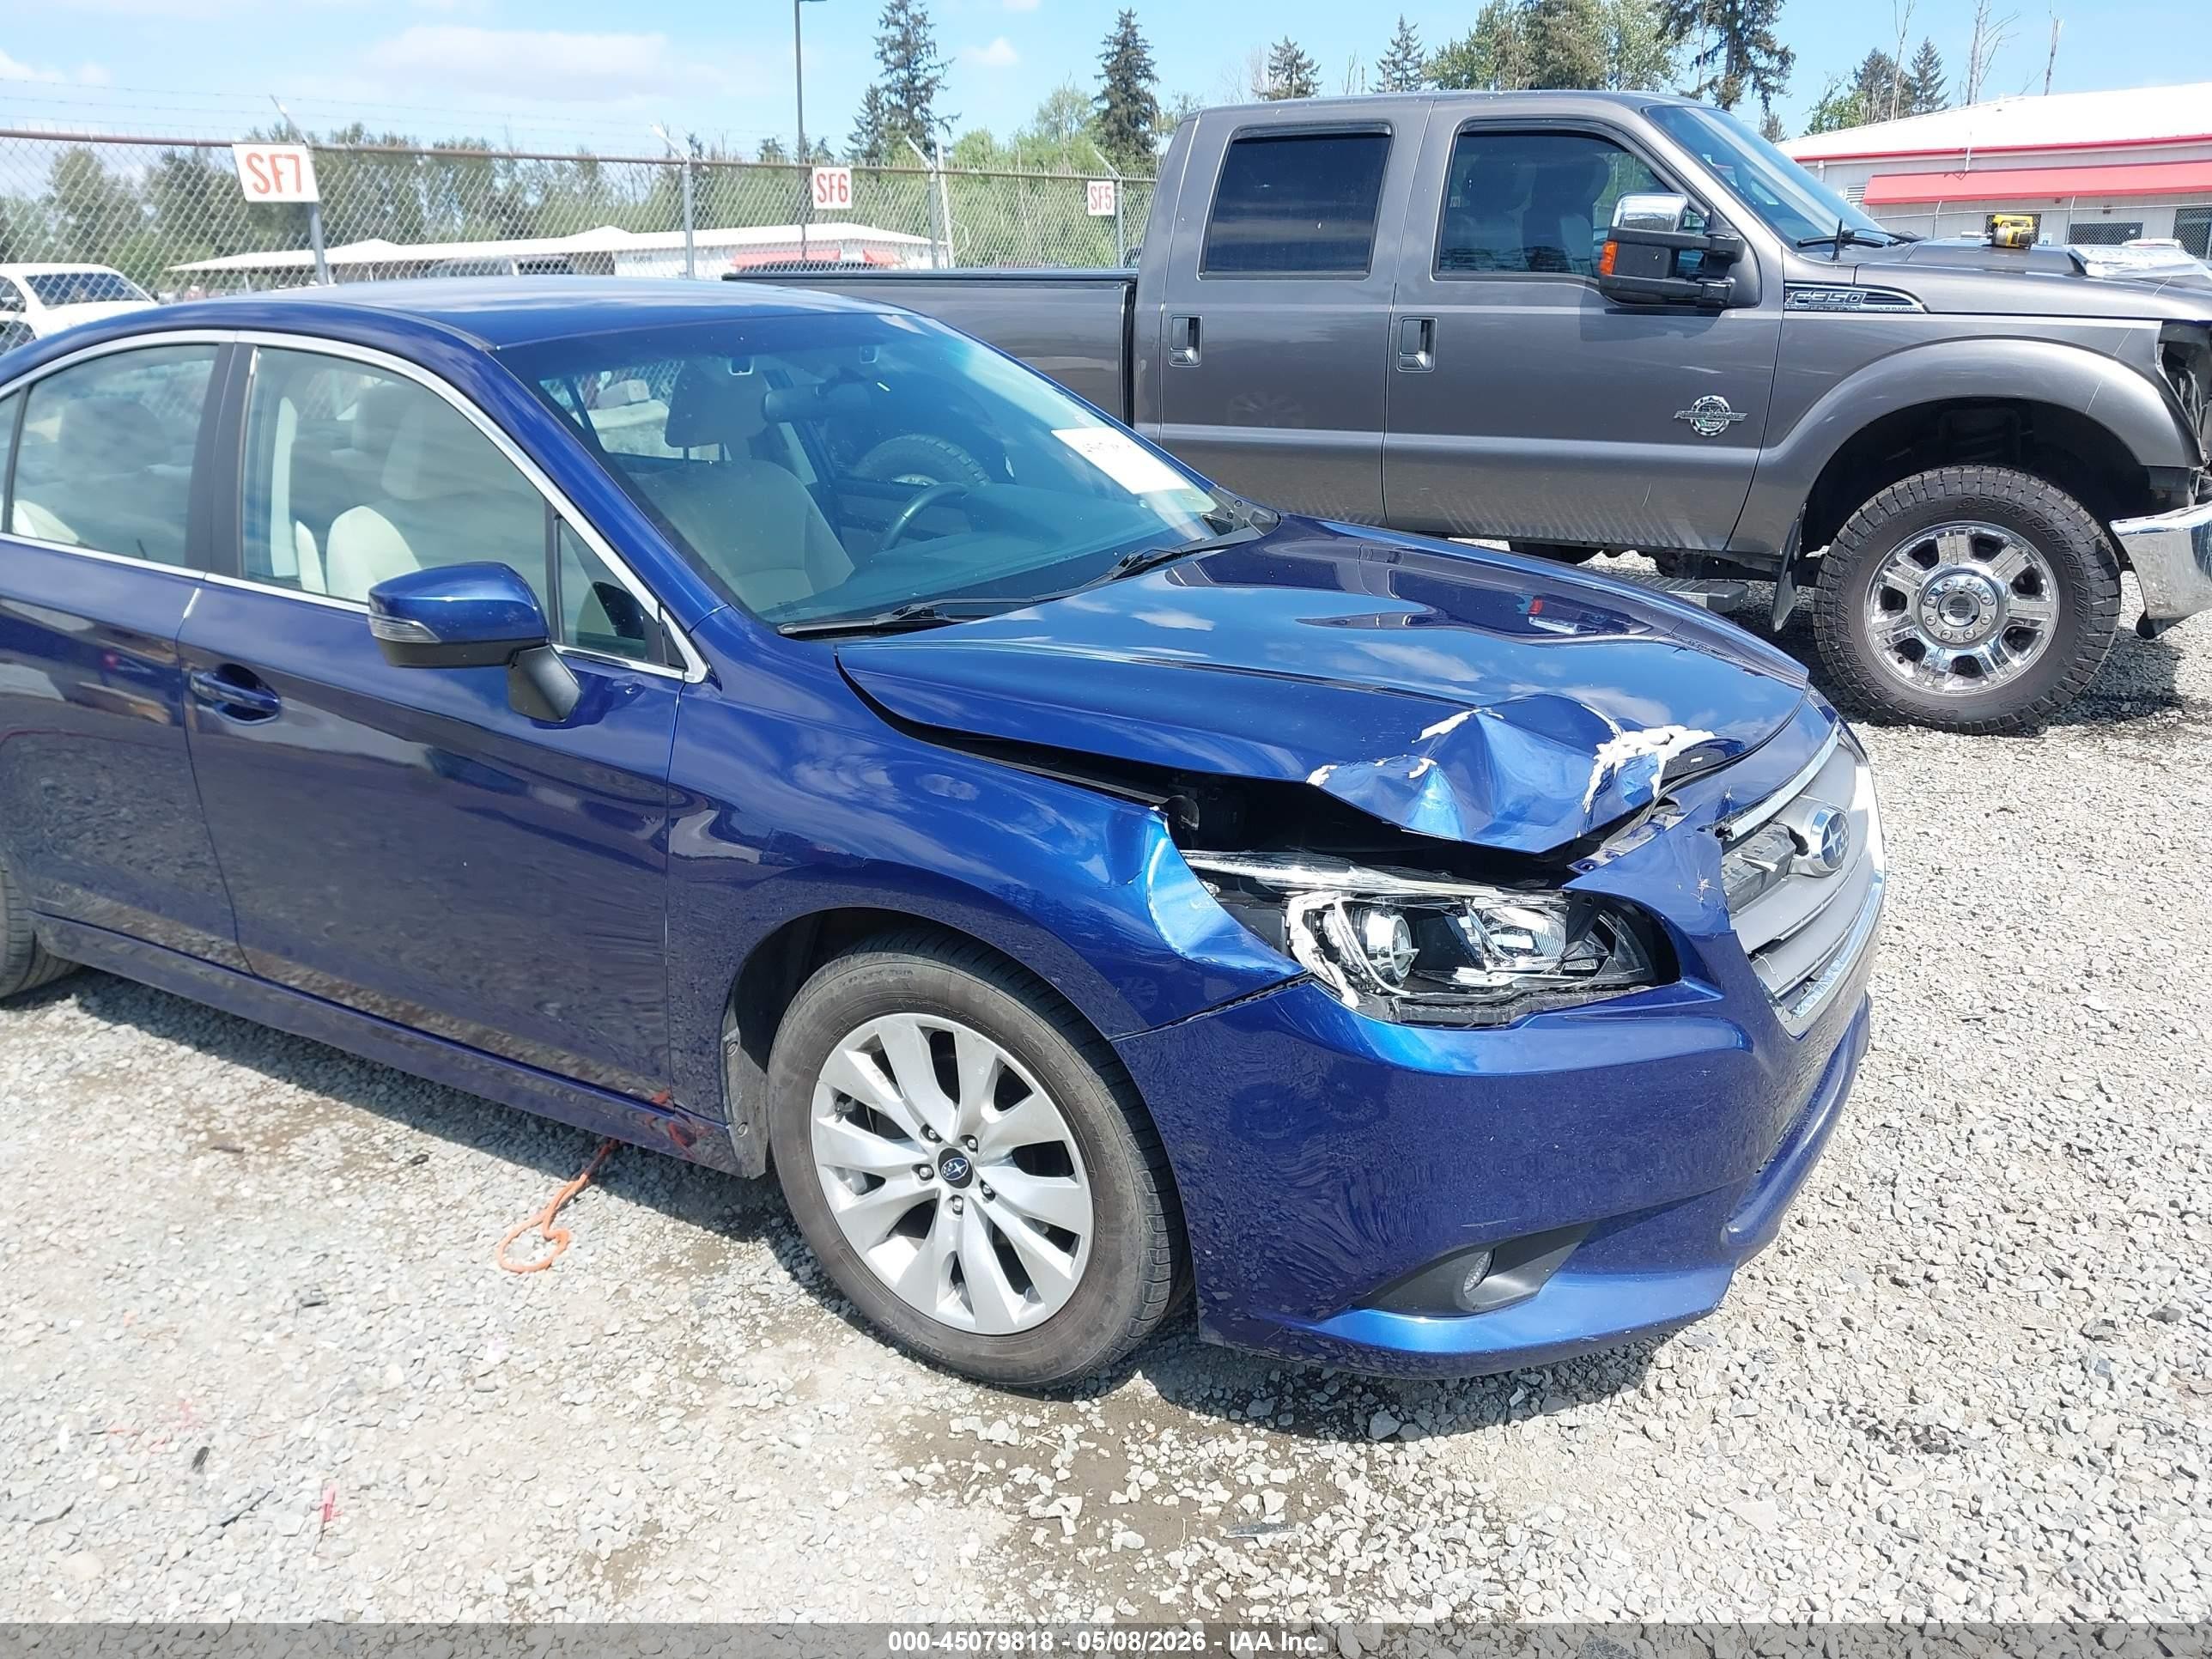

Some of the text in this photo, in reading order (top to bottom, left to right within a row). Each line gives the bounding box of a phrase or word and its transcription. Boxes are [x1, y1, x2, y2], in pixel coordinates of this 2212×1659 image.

[246, 152, 301, 194] SF7
[817, 173, 848, 203] SF6
[1091, 185, 1112, 210] SF5
